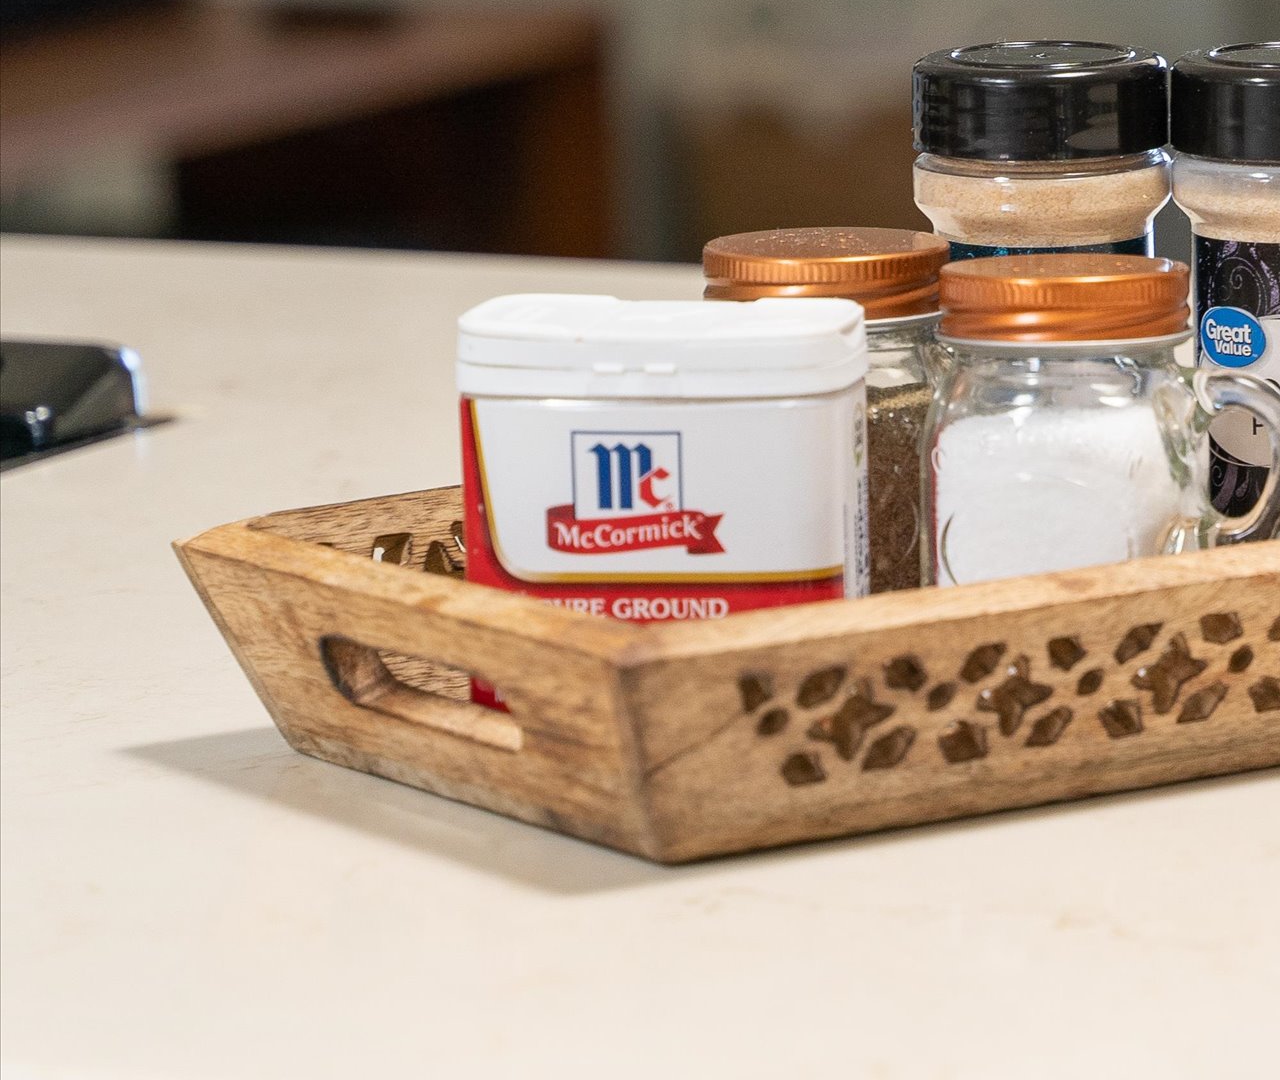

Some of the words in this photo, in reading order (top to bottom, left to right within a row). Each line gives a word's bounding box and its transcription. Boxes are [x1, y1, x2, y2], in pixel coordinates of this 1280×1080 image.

[1205, 318, 1252, 344] Great
[1214, 339, 1252, 357] Value
[553, 515, 703, 550] McCormick
[611, 597, 730, 621] GROUND
